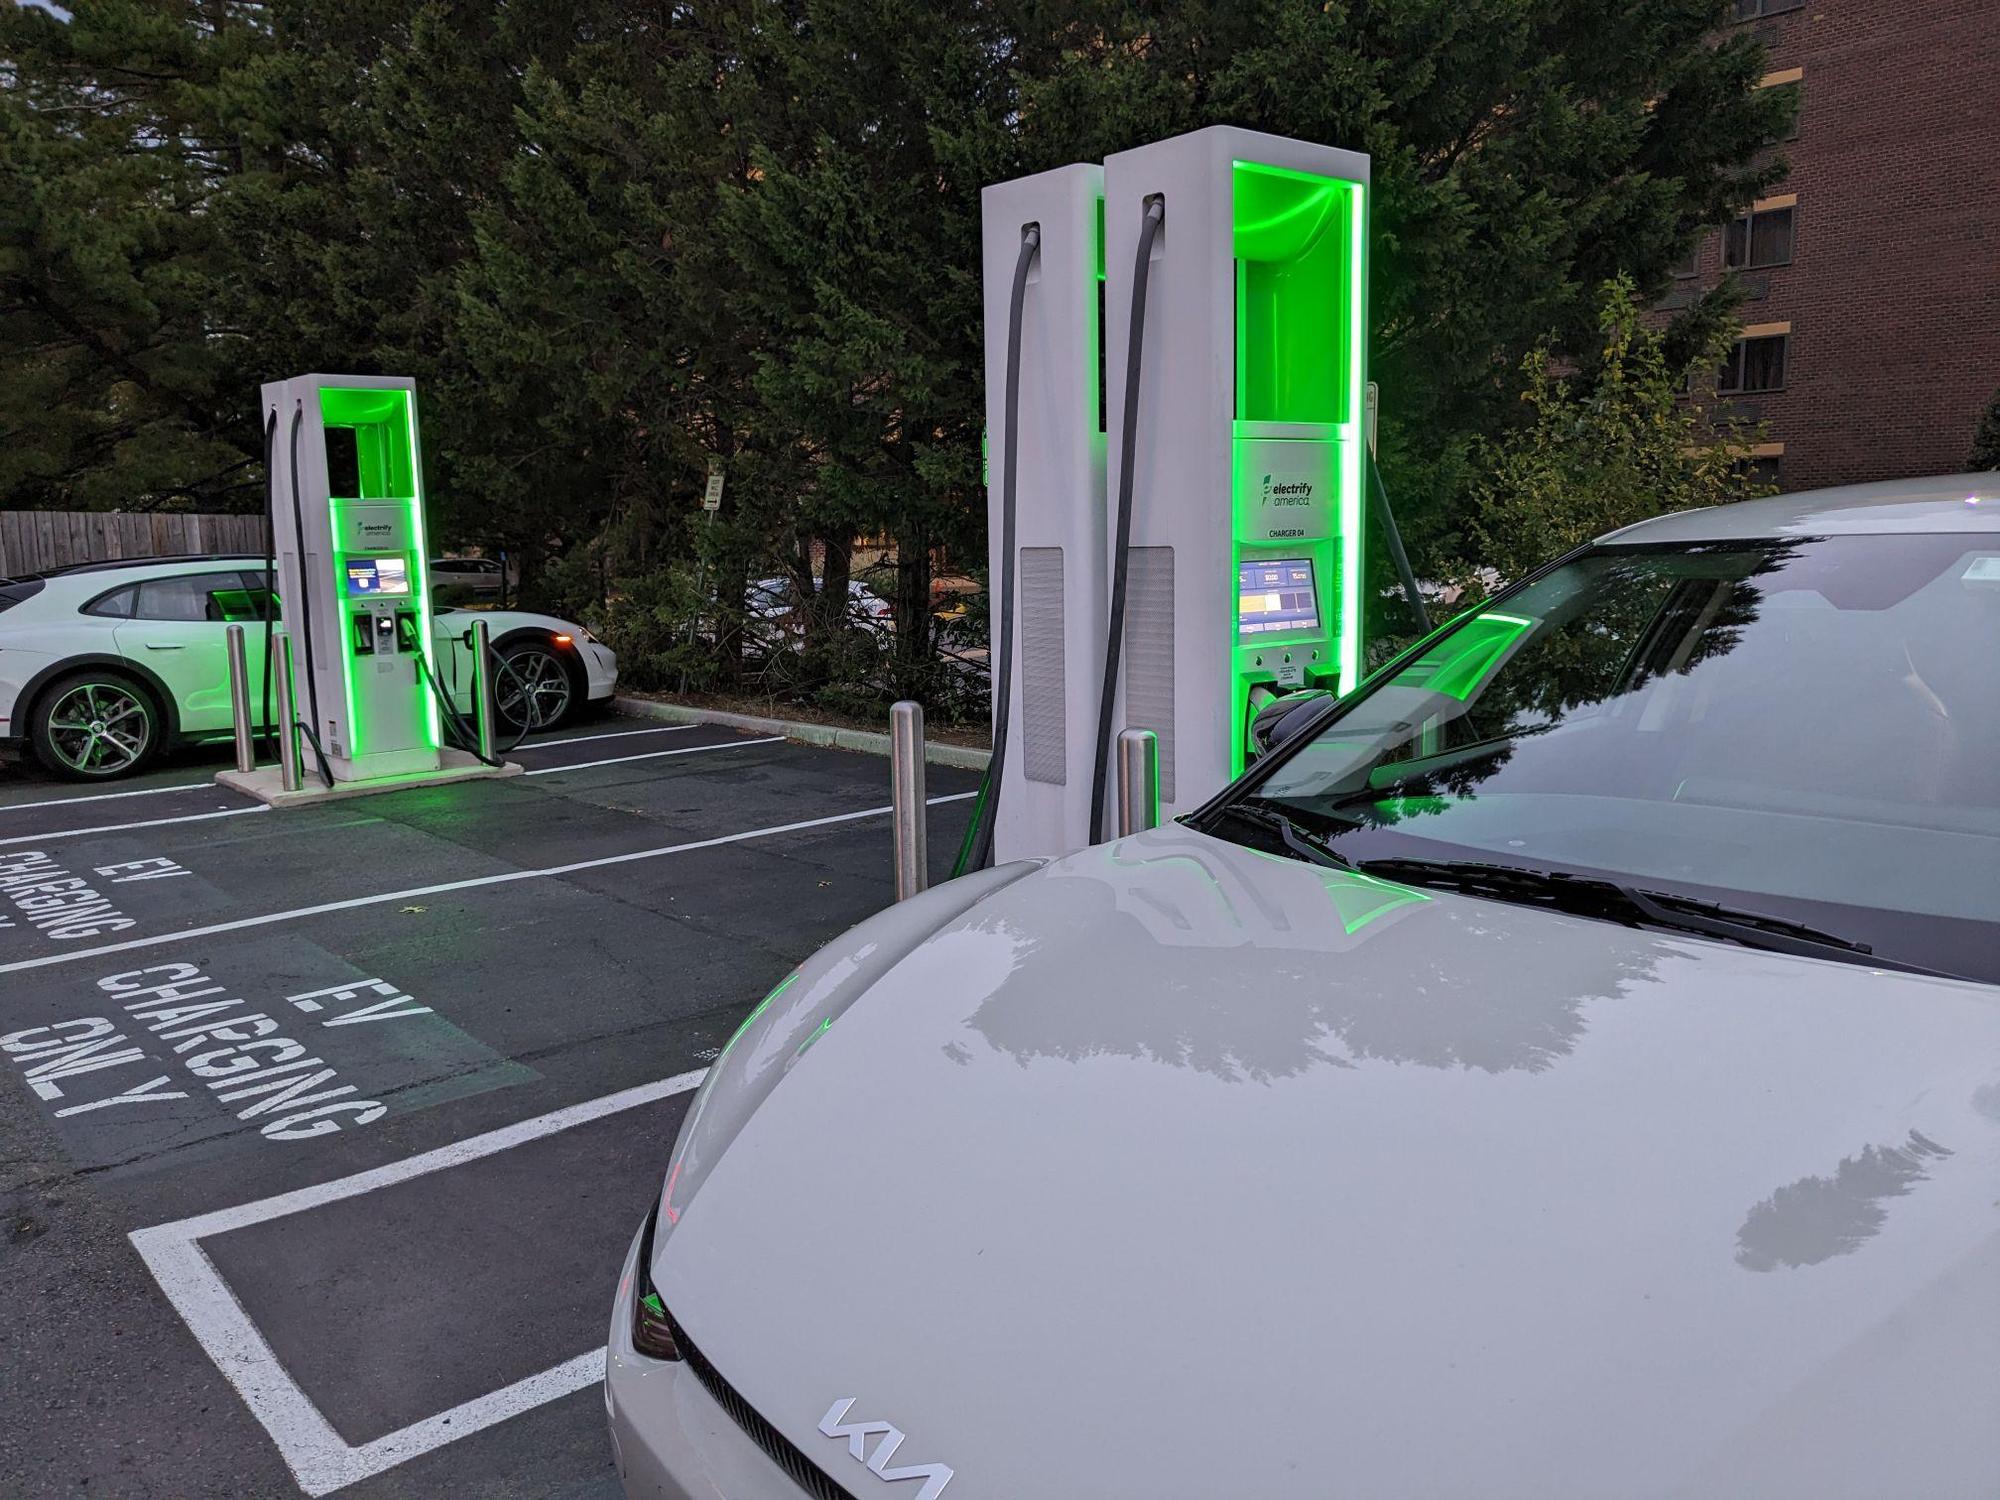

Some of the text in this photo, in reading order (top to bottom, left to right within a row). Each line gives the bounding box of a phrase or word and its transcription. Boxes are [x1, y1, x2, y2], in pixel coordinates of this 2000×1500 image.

[1273, 483, 1312, 496] electrify
[1274, 496, 1309, 506] america
[1269, 529, 1297, 538] CHARGER
[93, 857, 192, 883] EV
[286, 978, 434, 1027] EV
[97, 962, 387, 1139] CHARGING
[0, 1017, 189, 1118] ONLY
